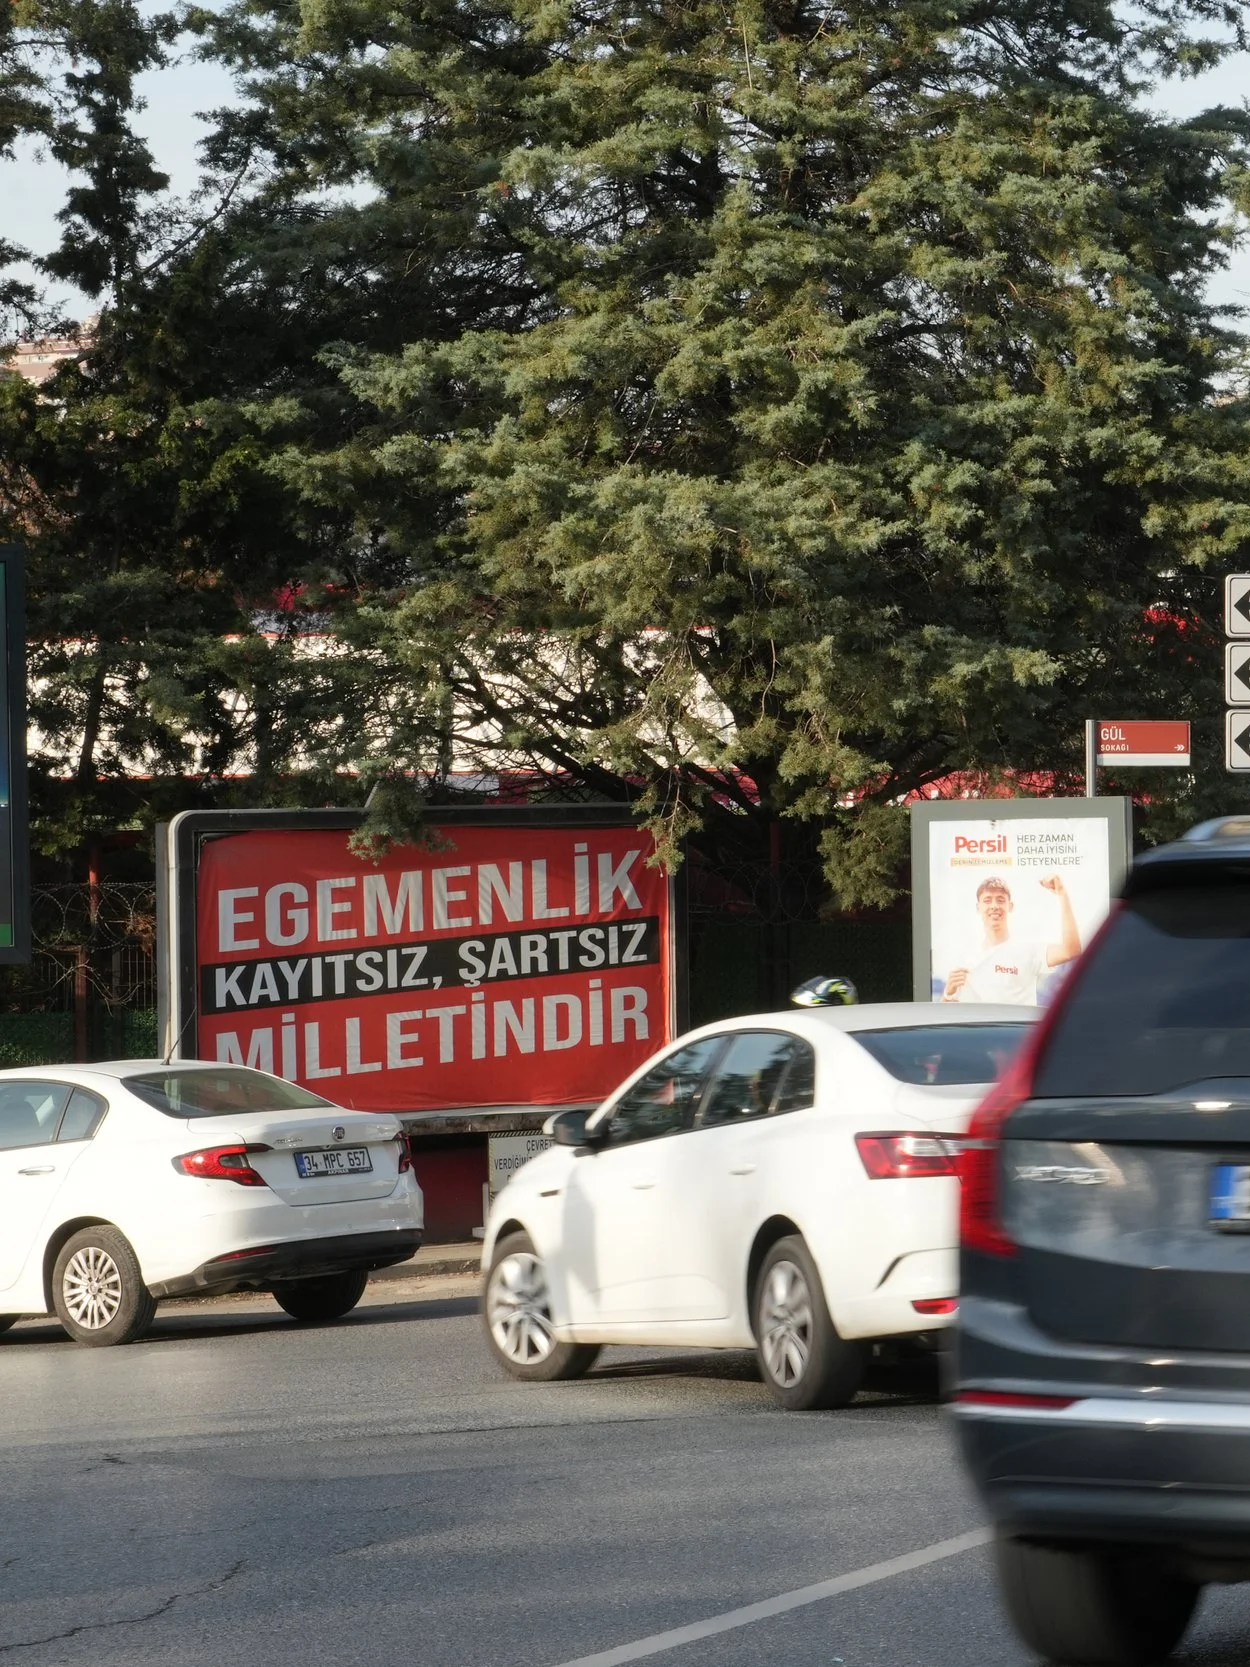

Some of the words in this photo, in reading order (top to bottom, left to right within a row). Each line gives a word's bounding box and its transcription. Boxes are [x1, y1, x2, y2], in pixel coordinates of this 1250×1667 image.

[1100, 725, 1126, 741] GÜL
[1100, 744, 1129, 752] SOKAĞI
[954, 834, 1007, 853] Persil
[1016, 834, 1036, 844] HER
[1038, 834, 1074, 844] ZAMAN
[1016, 845, 1044, 855] DAHA
[217, 842, 643, 953] EGEMENLİK
[214, 946, 442, 1008] KAYITSIZ,
[458, 922, 648, 988] ŞARTSIZ
[994, 964, 1019, 976] Persil
[303, 1155, 319, 1171] 34
[322, 1152, 344, 1170] MPC
[348, 1150, 366, 1167] 657
